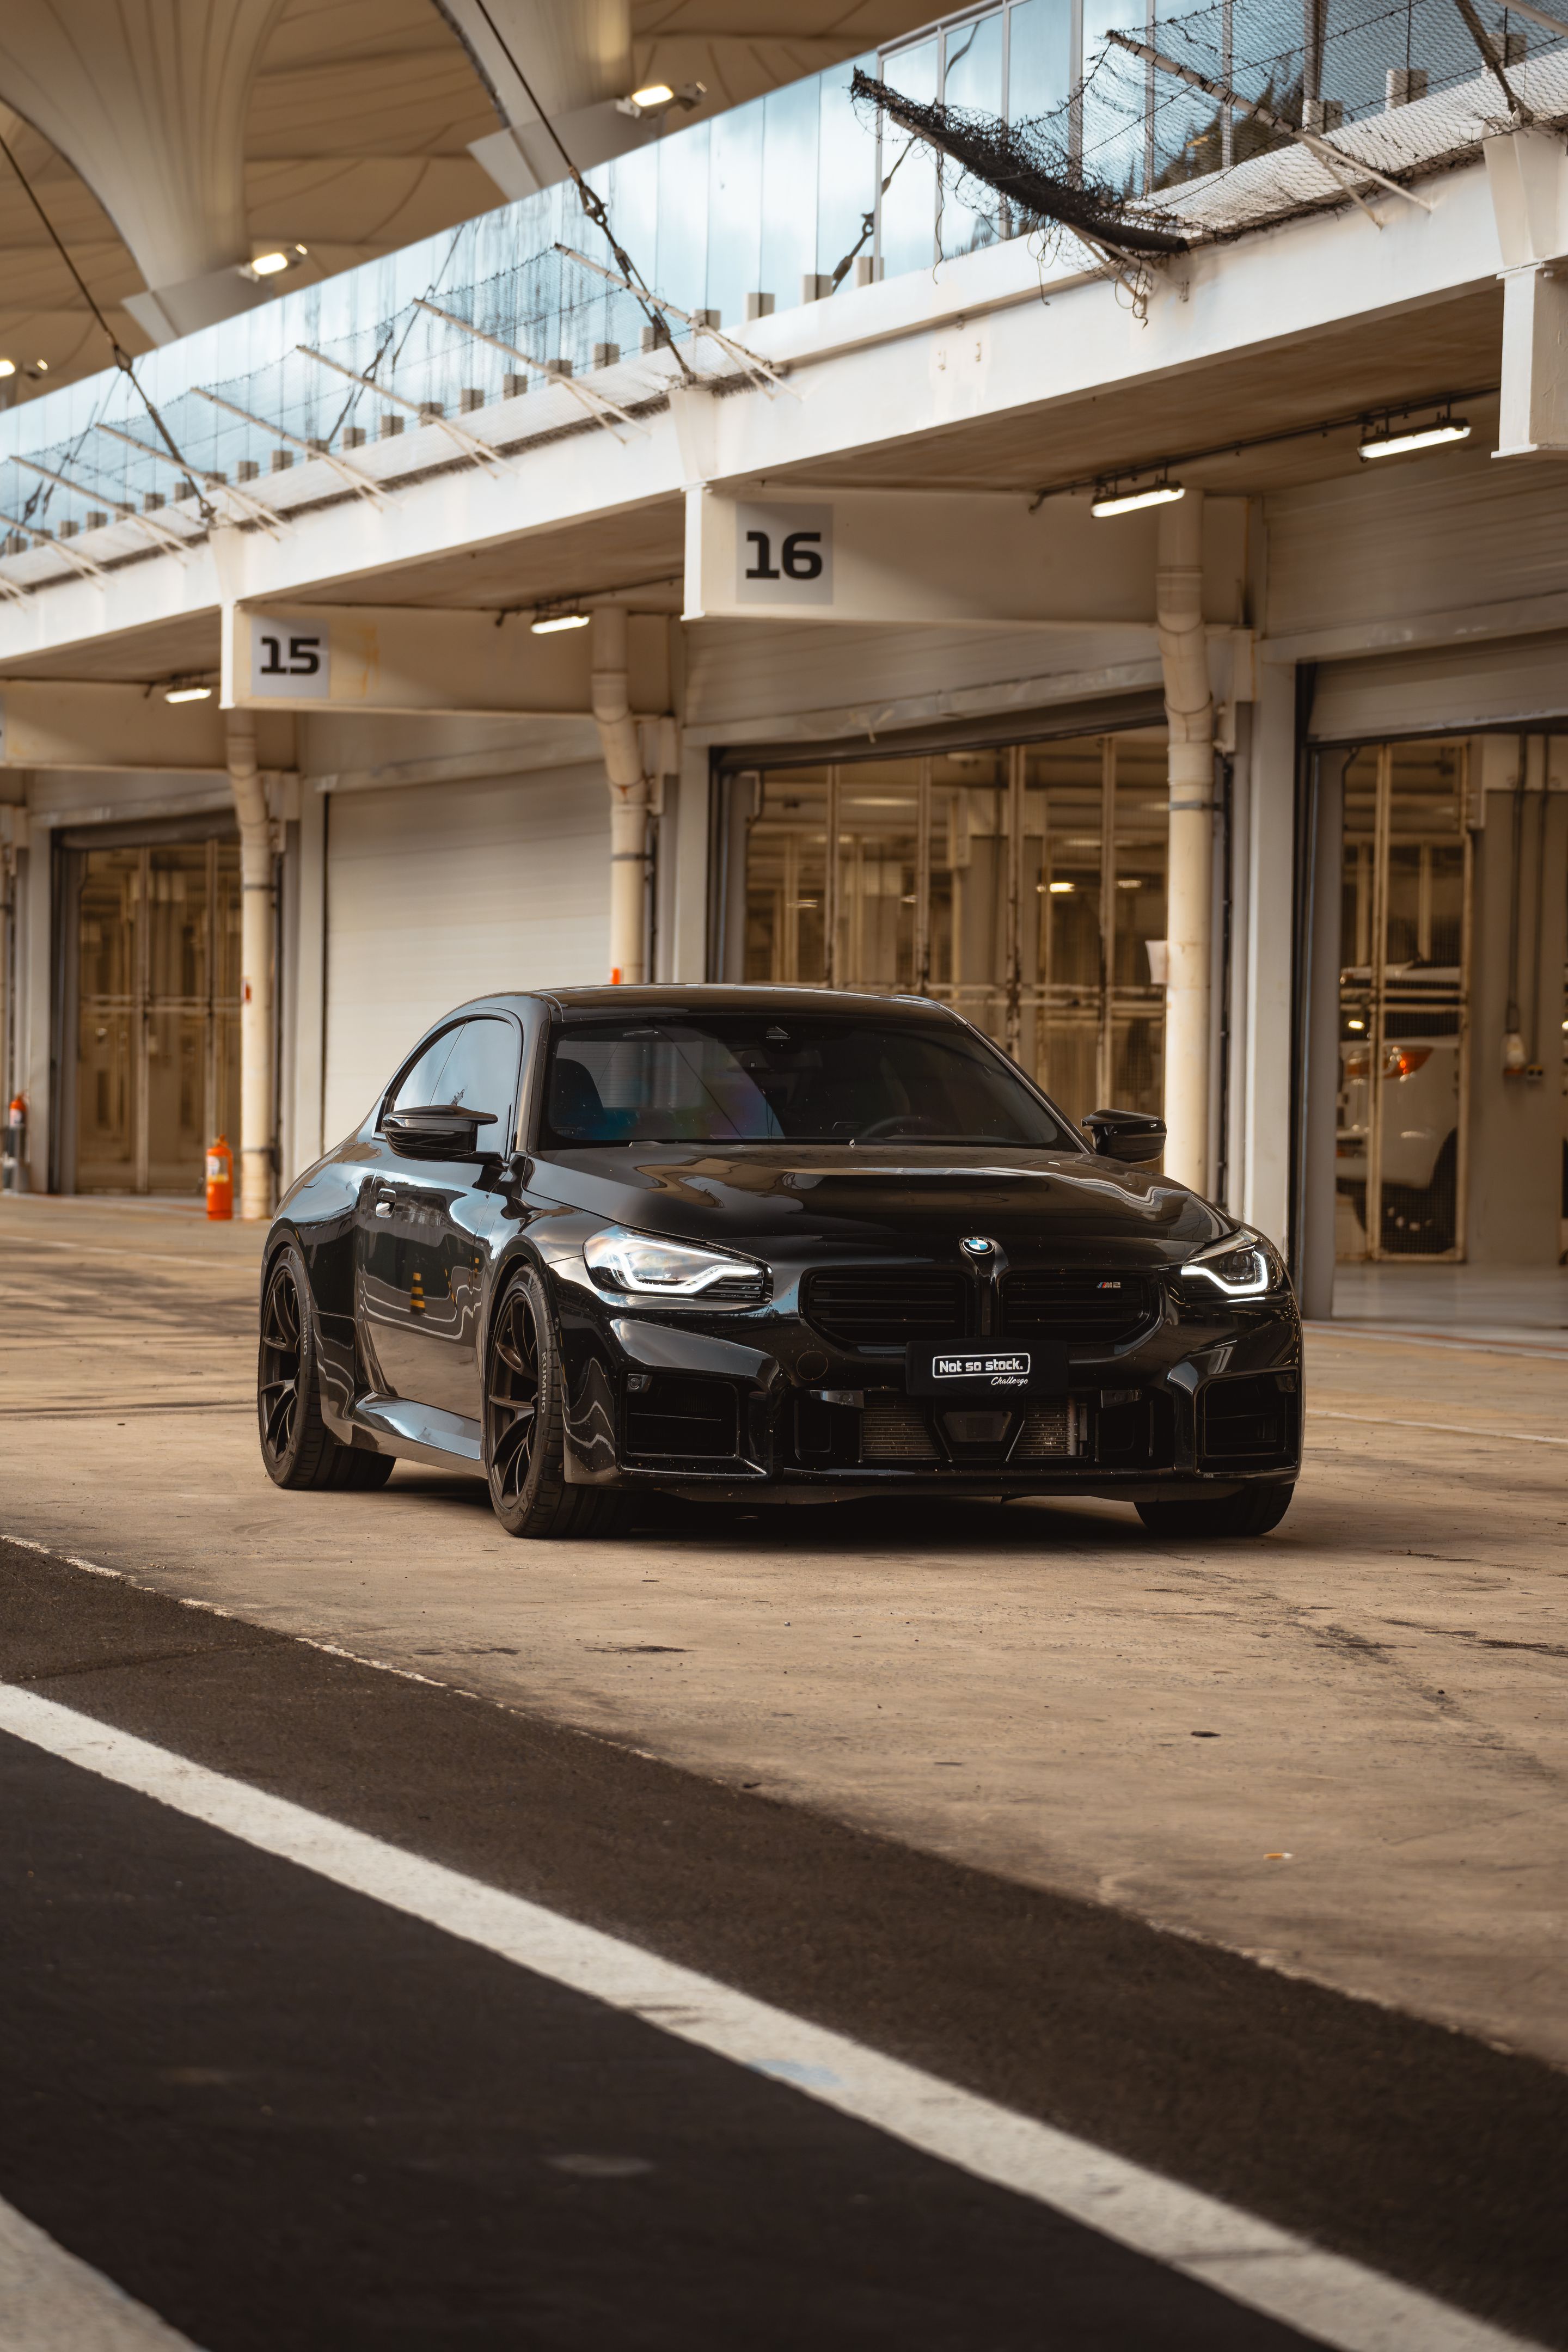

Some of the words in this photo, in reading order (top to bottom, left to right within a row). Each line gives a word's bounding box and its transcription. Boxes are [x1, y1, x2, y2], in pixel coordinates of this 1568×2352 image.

[746, 531, 822, 580] 16
[261, 636, 320, 675] 15
[940, 1360, 962, 1373] Not
[965, 1362, 982, 1372] so
[985, 1358, 1023, 1371] stock.
[991, 1376, 1028, 1387] Challenge
